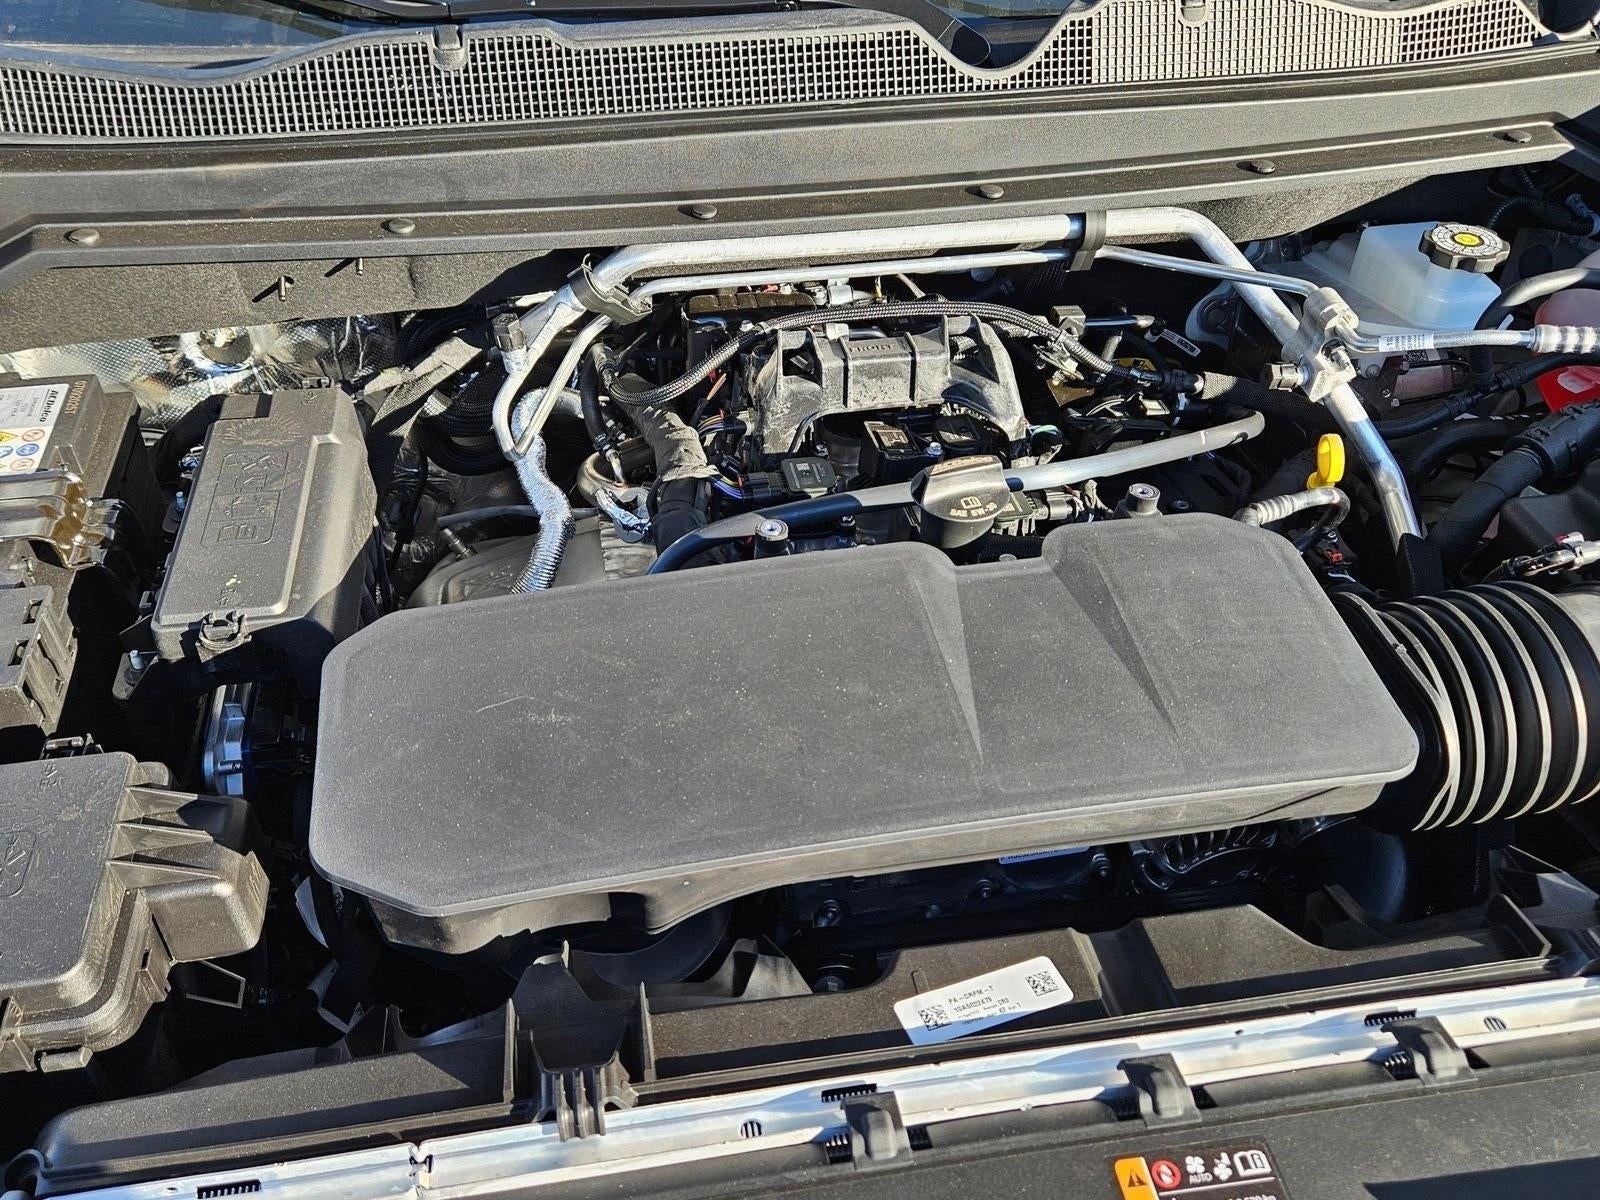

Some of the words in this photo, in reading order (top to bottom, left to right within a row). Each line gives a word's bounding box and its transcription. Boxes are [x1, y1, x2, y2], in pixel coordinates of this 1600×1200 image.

[39, 389, 59, 423] ACDelco
[949, 508, 968, 517] SAE
[970, 502, 998, 516] 5W-30
[1189, 1172, 1213, 1185] AUTO
